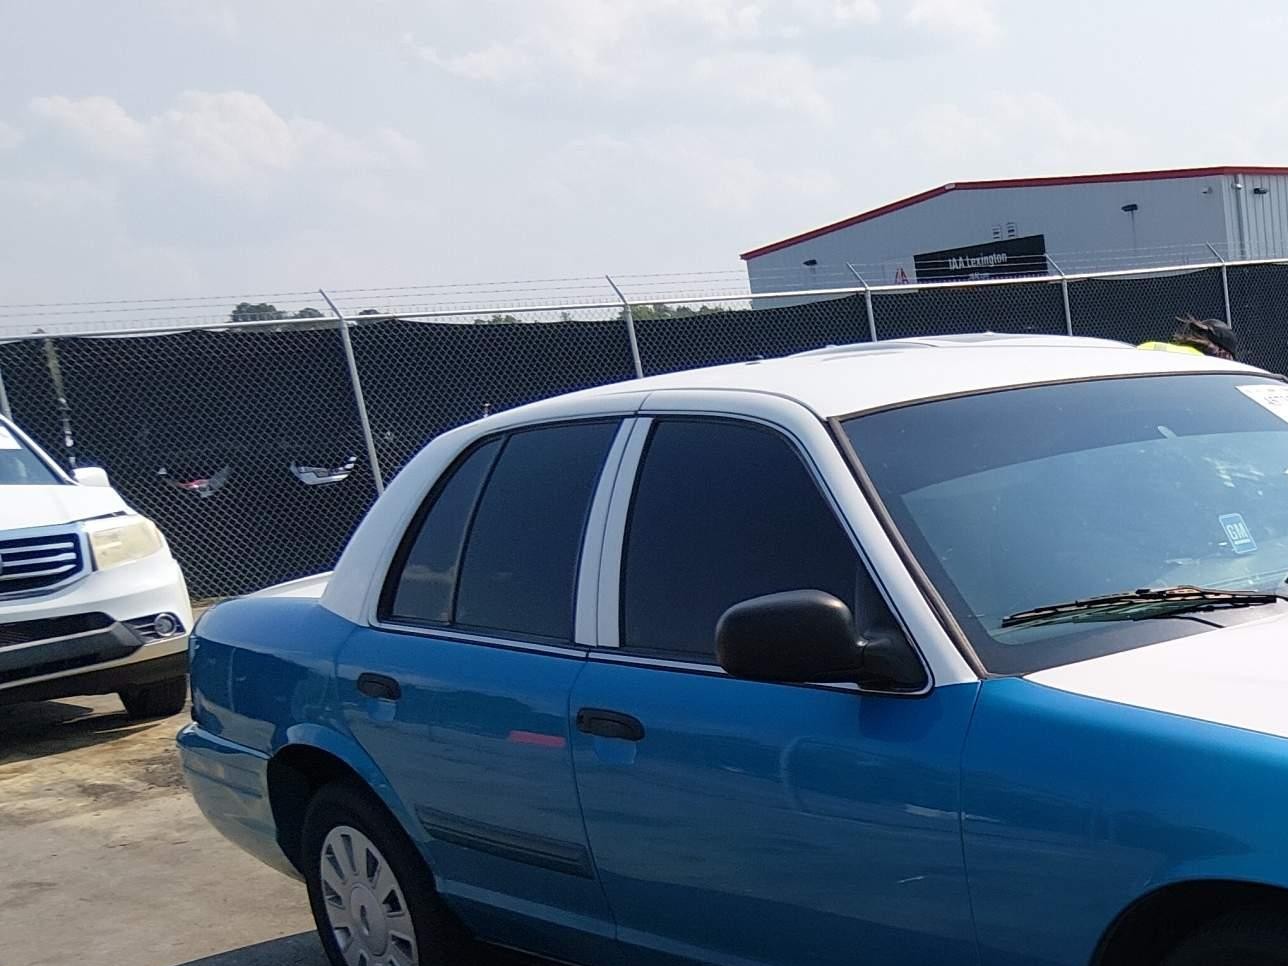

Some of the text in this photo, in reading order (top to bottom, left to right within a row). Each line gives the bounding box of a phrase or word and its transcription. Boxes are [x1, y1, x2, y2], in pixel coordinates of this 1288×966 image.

[948, 252, 1008, 271] IAA Lexington
[1226, 522, 1249, 540] GM
